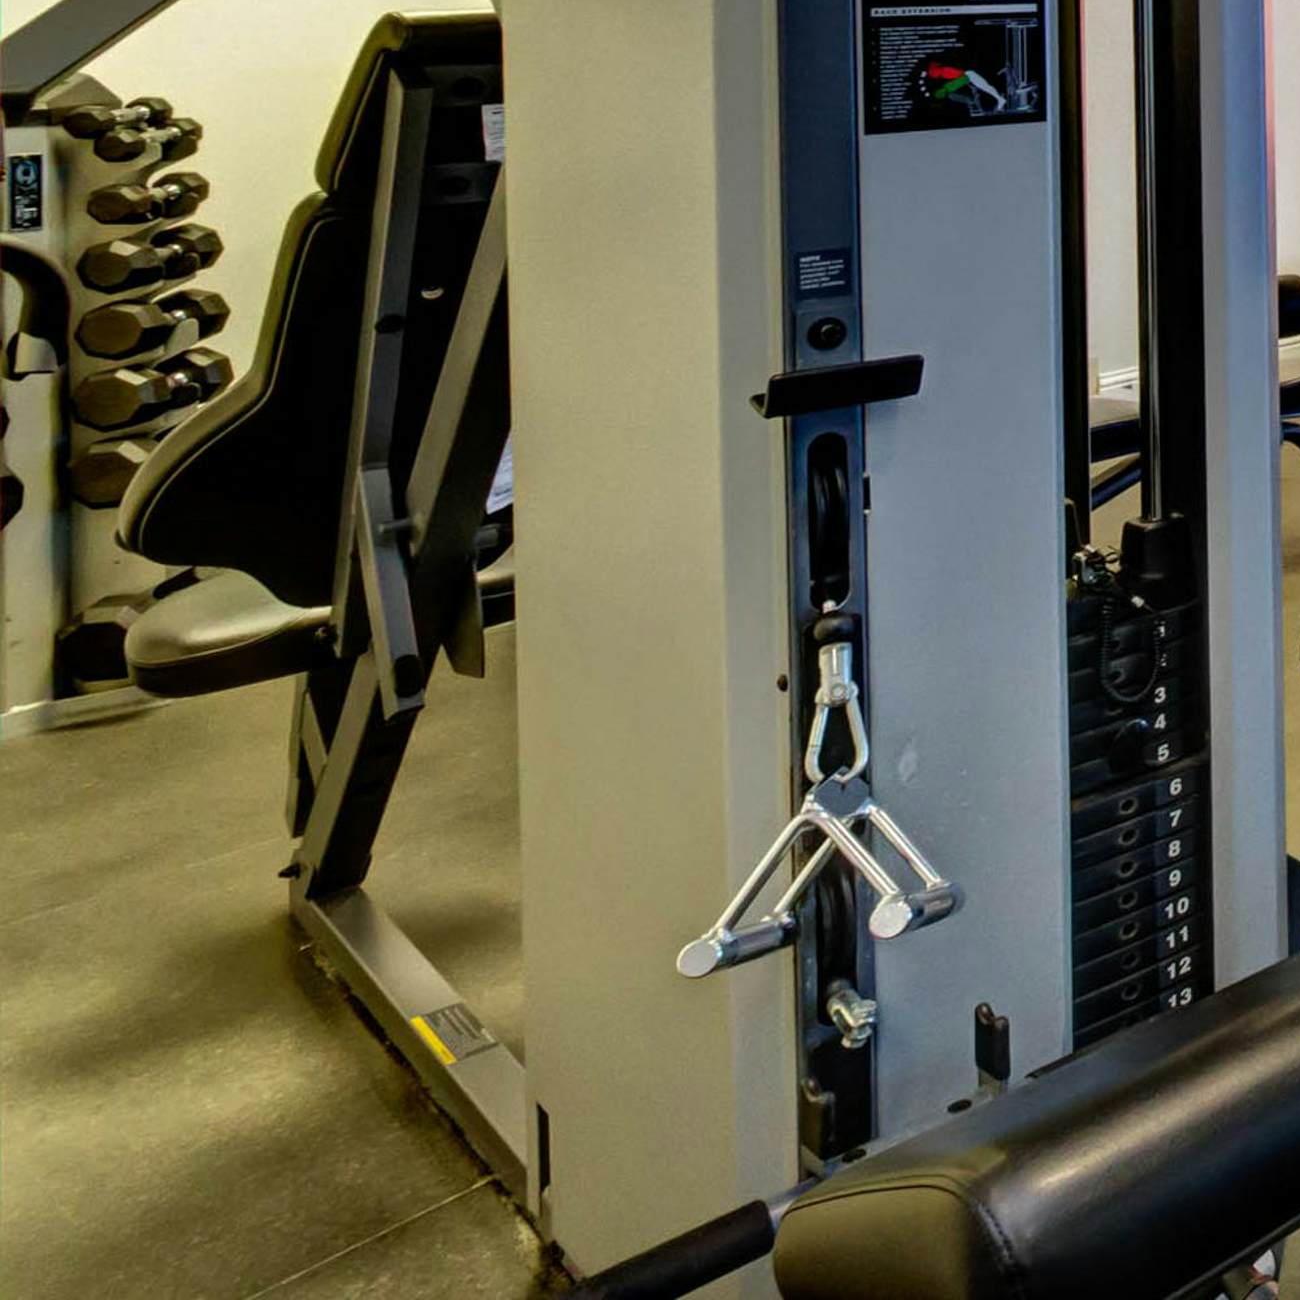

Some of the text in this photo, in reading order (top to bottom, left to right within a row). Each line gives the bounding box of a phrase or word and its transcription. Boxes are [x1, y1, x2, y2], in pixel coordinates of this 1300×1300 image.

[1154, 686, 1166, 703] 3
[1154, 713, 1166, 729] 4
[1157, 743, 1169, 761] 5
[1169, 778, 1182, 796] 6
[1169, 809, 1182, 828] 7
[1168, 840, 1181, 858] 8
[1168, 869, 1182, 887] 9
[1164, 896, 1189, 919] 10
[1166, 925, 1189, 948] 11
[1167, 956, 1192, 979] 12
[1168, 987, 1192, 1007] 13
